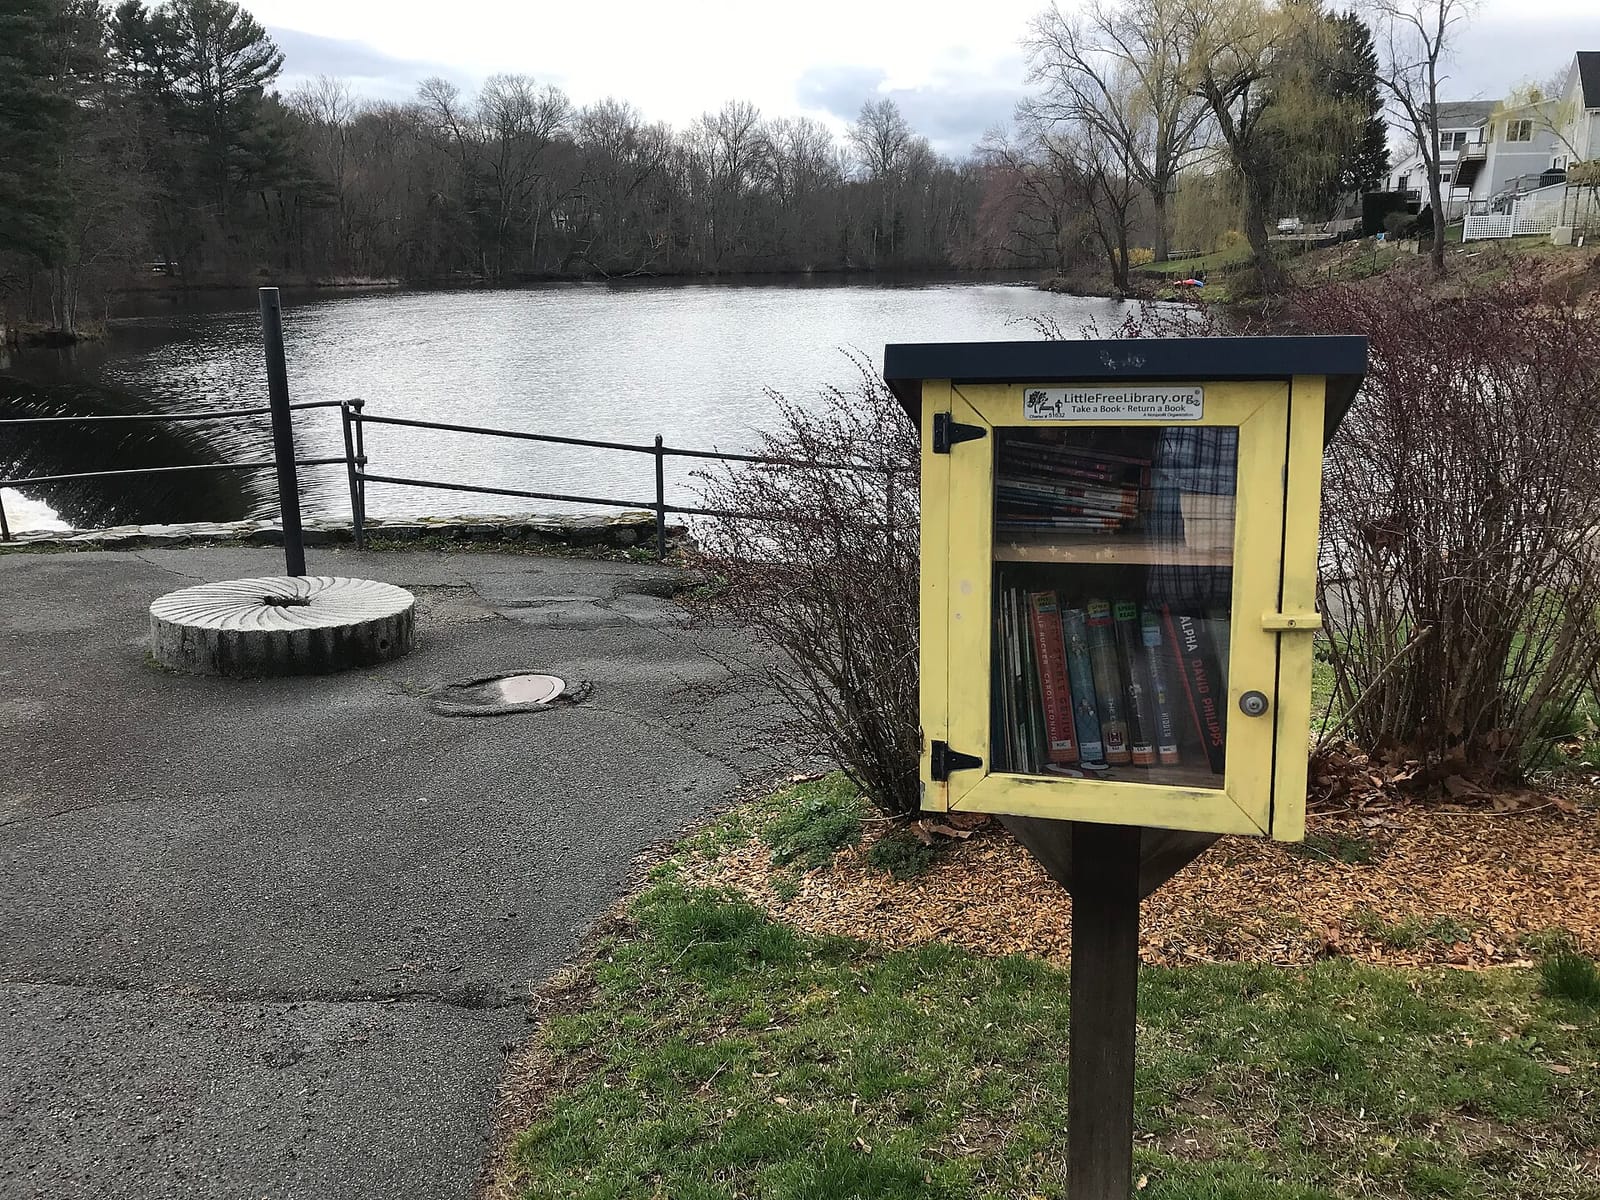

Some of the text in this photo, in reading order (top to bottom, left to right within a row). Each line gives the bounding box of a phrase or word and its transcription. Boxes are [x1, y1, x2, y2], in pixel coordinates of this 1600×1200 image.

[1064, 392, 1194, 405] LittleFreeLibrary.org
[1072, 405, 1091, 413] Take
[1100, 405, 1121, 413] Book
[1127, 405, 1156, 413] Return
[1164, 404, 1186, 412] Book
[1043, 672, 1053, 702] CAROL
[1179, 615, 1224, 747] ALPHA DAVID PHILIPPS
